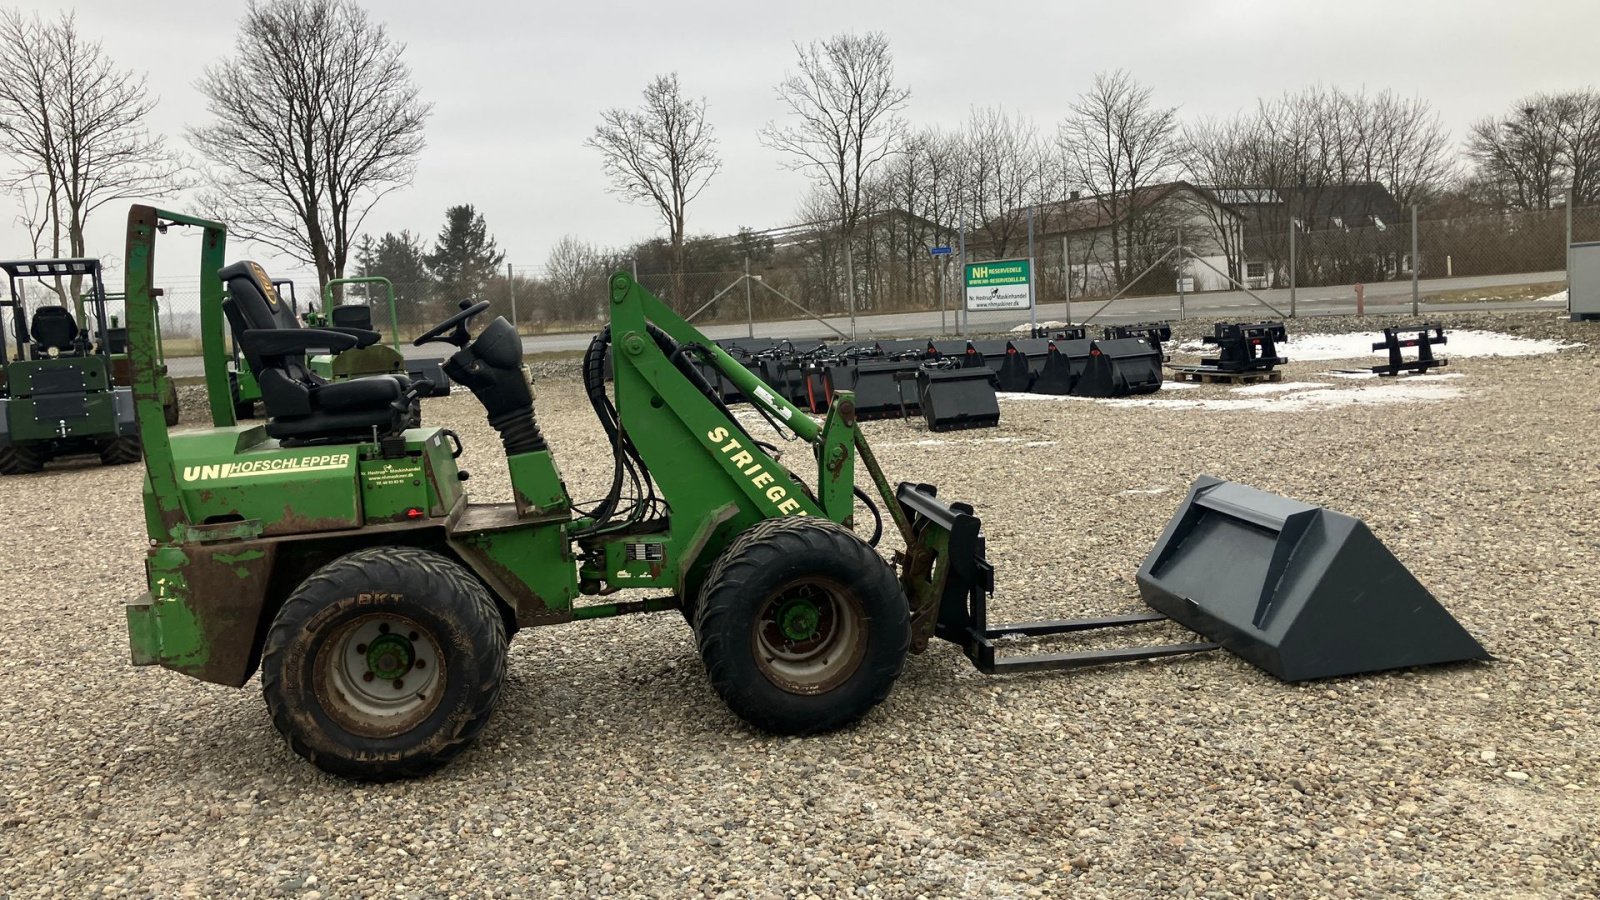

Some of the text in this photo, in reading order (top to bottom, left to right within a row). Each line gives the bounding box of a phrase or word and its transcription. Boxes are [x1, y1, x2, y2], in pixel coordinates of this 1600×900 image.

[972, 266, 1022, 279] NH RESERVEDELE
[996, 292, 1027, 300] Maskinhandel
[976, 300, 1020, 308] www.nhmaskiner.dk
[183, 453, 350, 481] UNI HOFSCHLEPPER
[707, 426, 808, 517] STRIEGE
[358, 593, 404, 605] BKT
